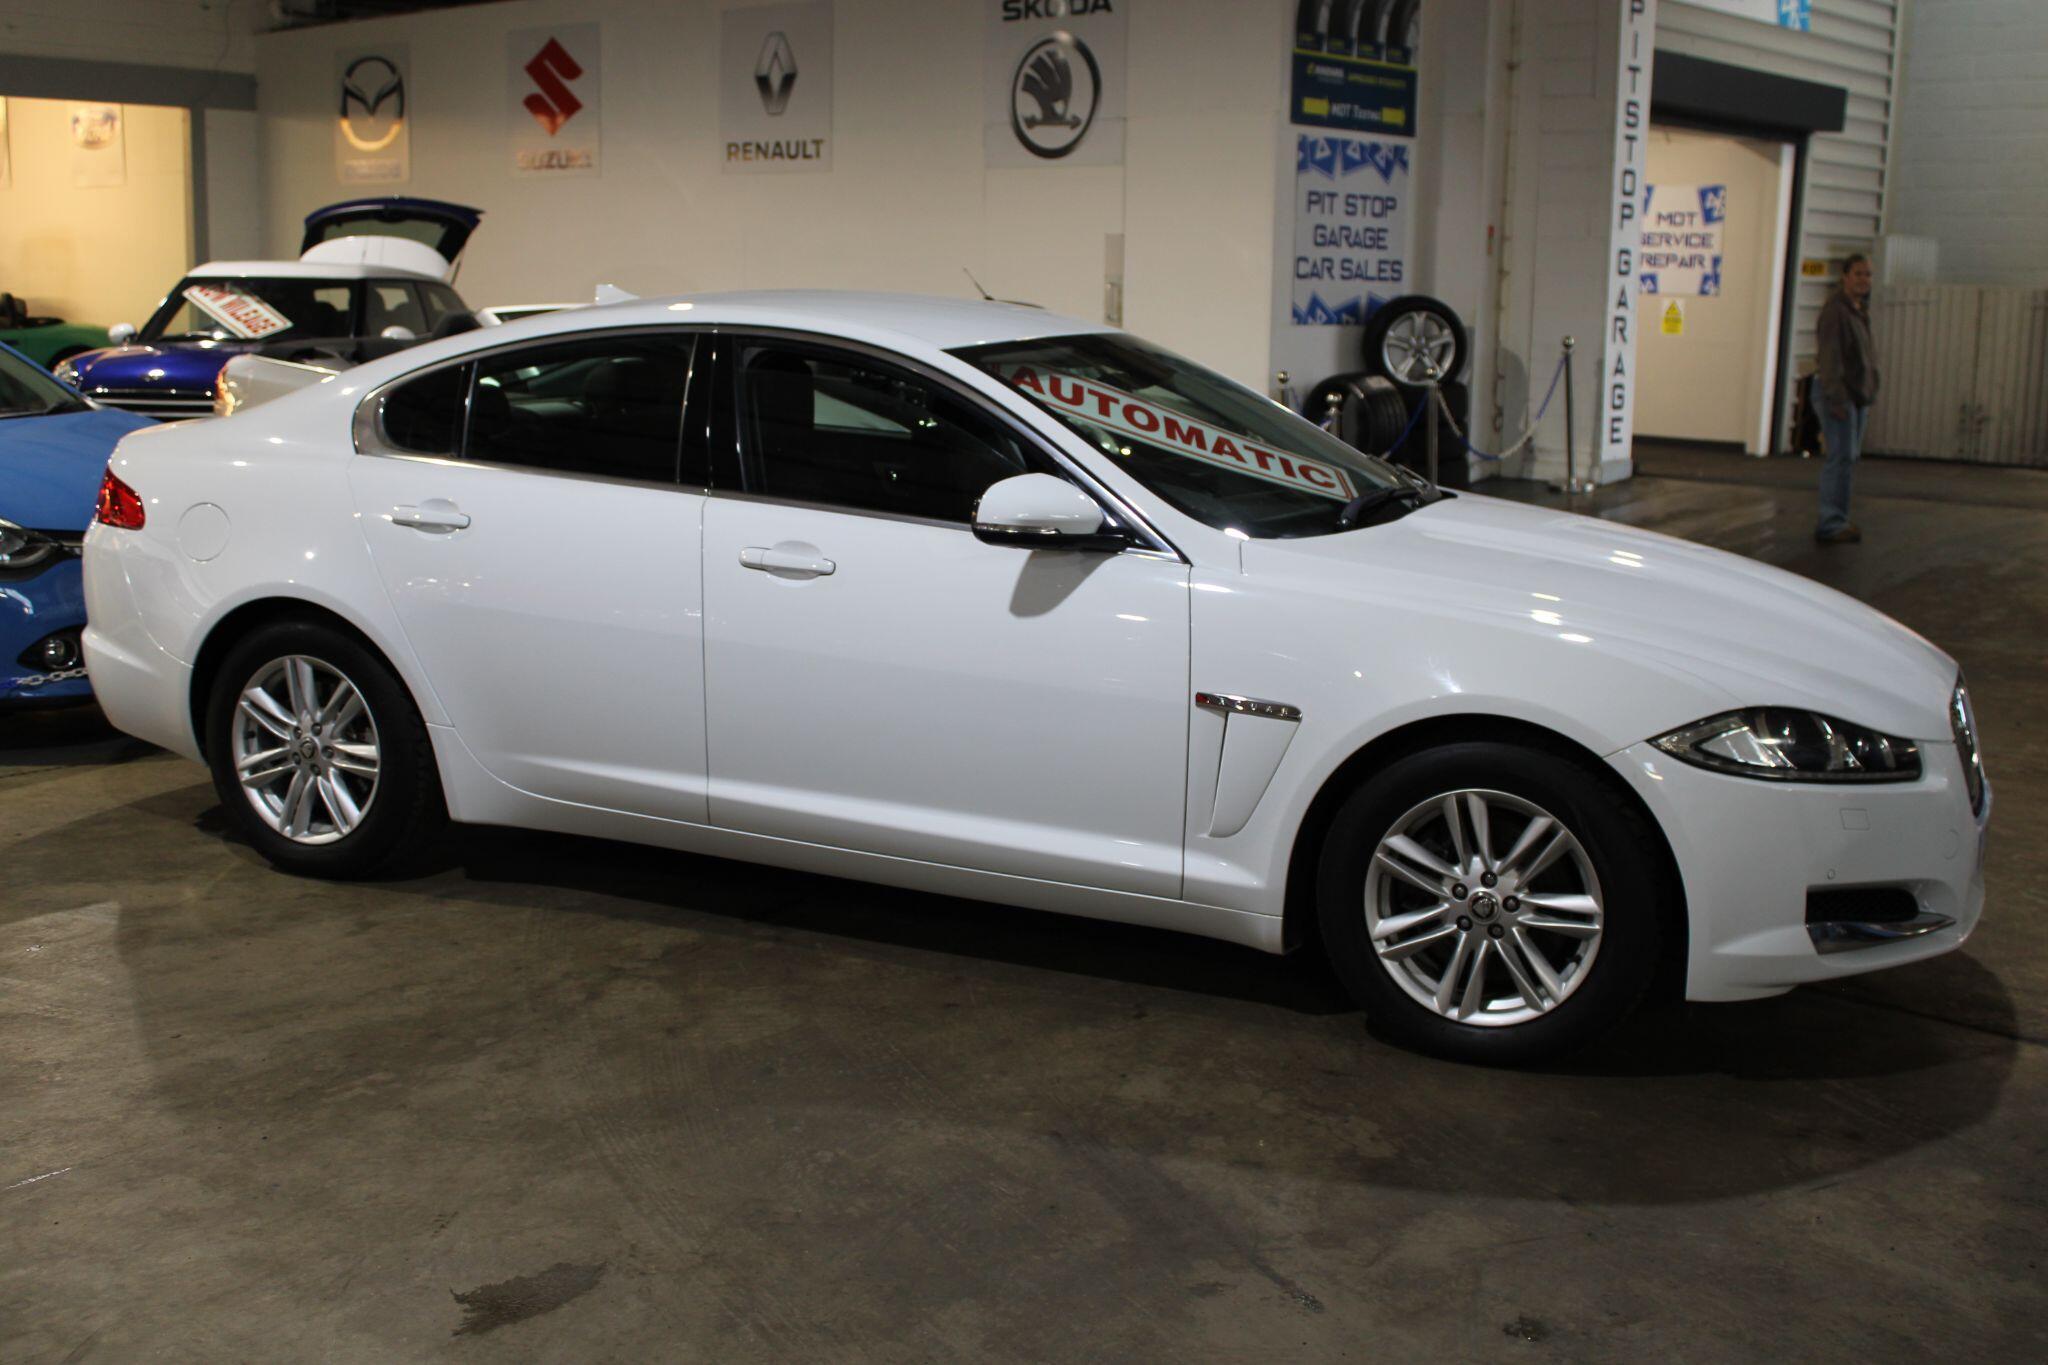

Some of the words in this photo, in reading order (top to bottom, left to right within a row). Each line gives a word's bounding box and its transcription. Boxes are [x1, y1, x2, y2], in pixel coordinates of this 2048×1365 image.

[726, 138, 825, 162] RENAULT
[1306, 190, 1339, 214] PIT
[1344, 193, 1398, 218] STOP
[1657, 211, 1697, 227] MOT
[1313, 223, 1389, 250] GARAGE
[1295, 256, 1335, 280] CAR
[1340, 257, 1404, 282] SALES
[1641, 252, 1706, 269] REPAIR
[1610, 249, 1632, 444] GARAGE
[1010, 366, 1338, 489] AUTOMATIC
